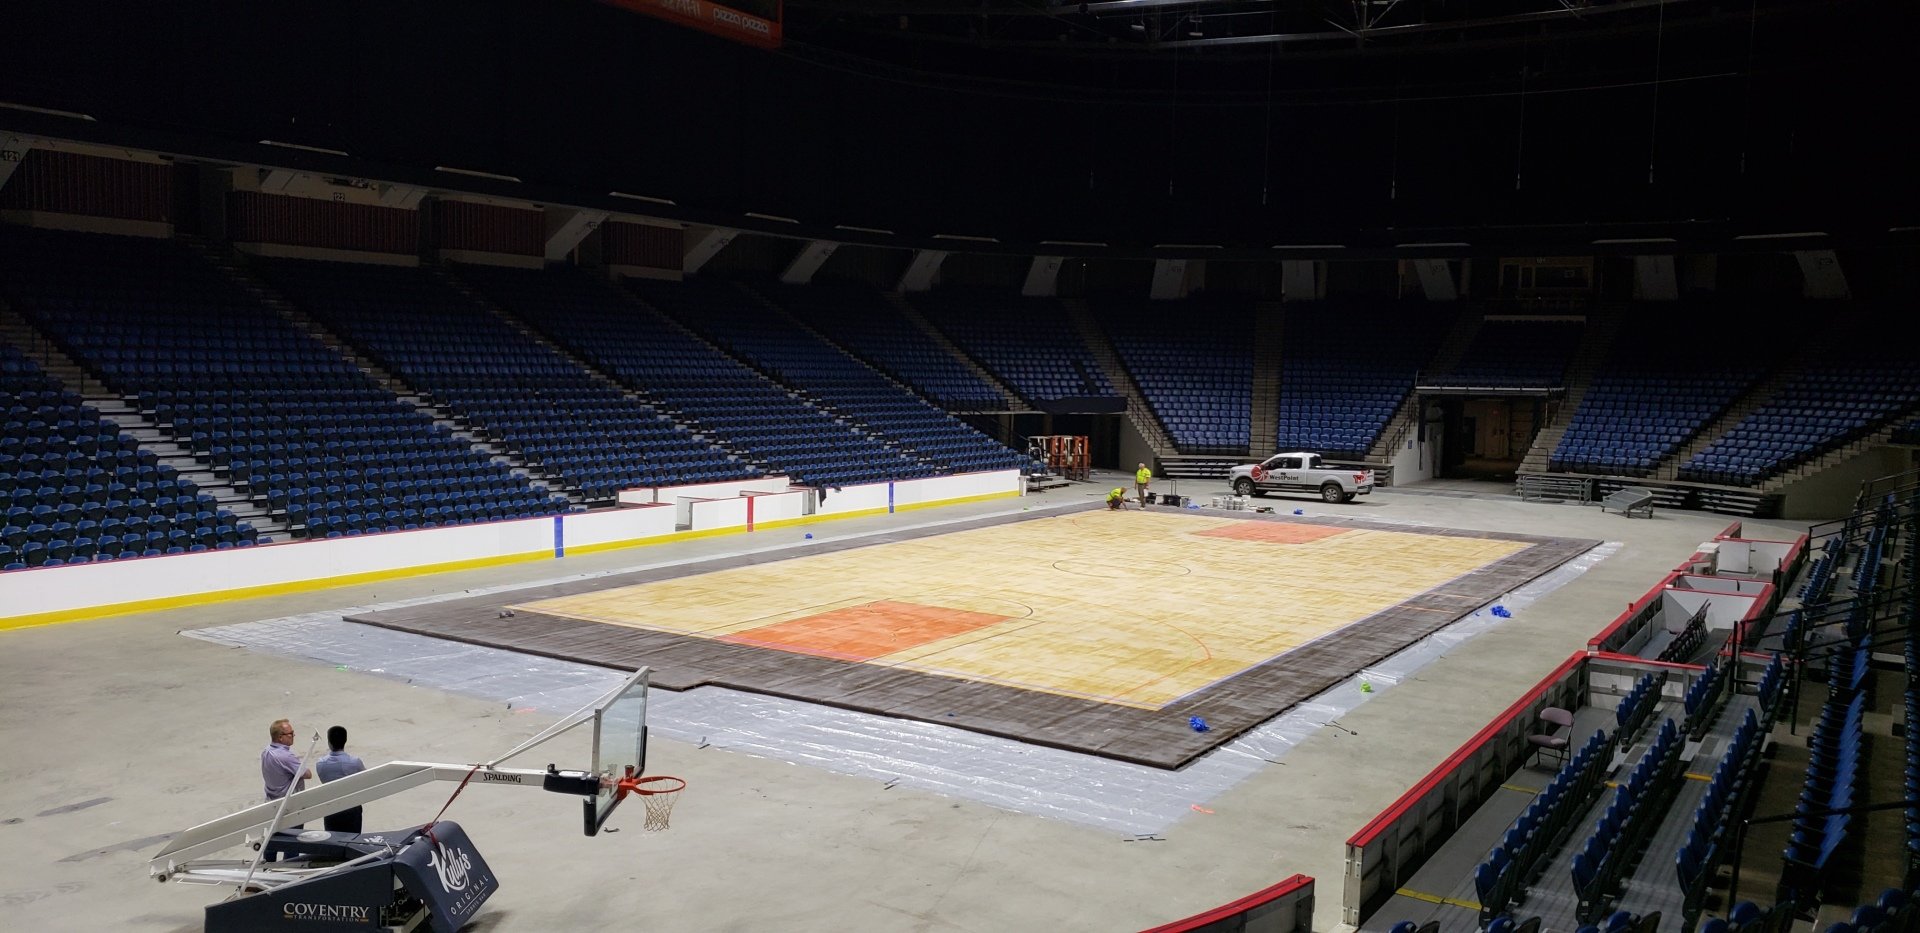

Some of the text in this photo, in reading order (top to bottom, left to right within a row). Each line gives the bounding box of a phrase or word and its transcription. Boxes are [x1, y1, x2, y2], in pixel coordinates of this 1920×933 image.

[483, 772, 522, 783] SPALDING
[450, 875, 489, 915] ORIGINAL
[283, 902, 370, 918] COVENTRY
